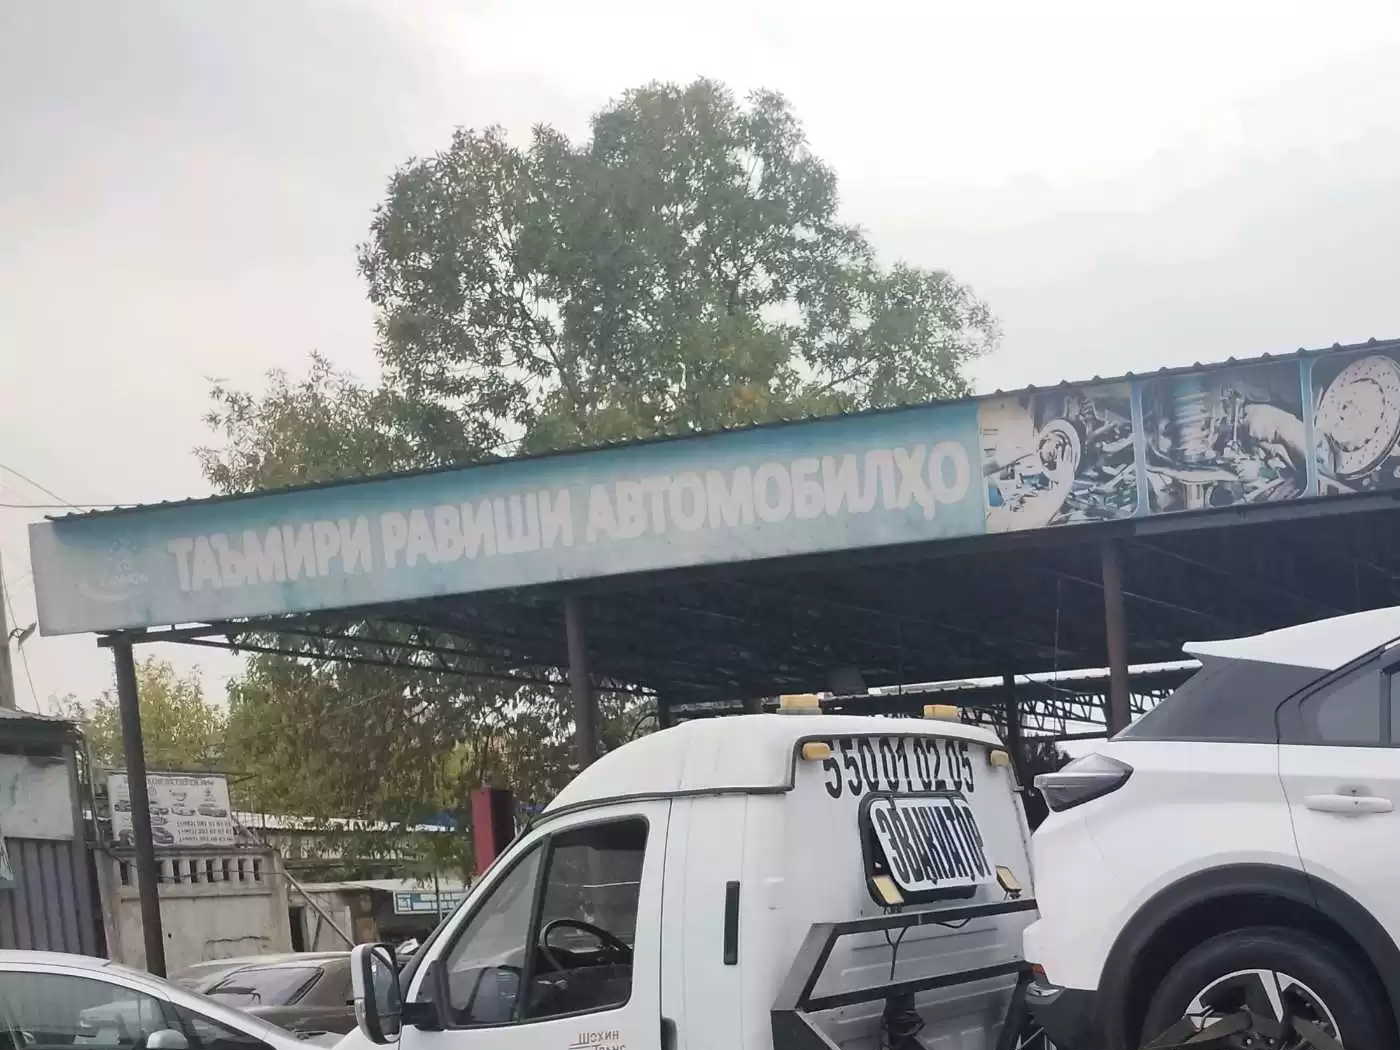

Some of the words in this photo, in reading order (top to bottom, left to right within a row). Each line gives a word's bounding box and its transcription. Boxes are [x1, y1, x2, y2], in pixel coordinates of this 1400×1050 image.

[168, 514, 373, 593] ТАЪМИРИ
[380, 489, 575, 569] РАВИШИ
[585, 440, 970, 545] АВТОМОБИЛҲО
